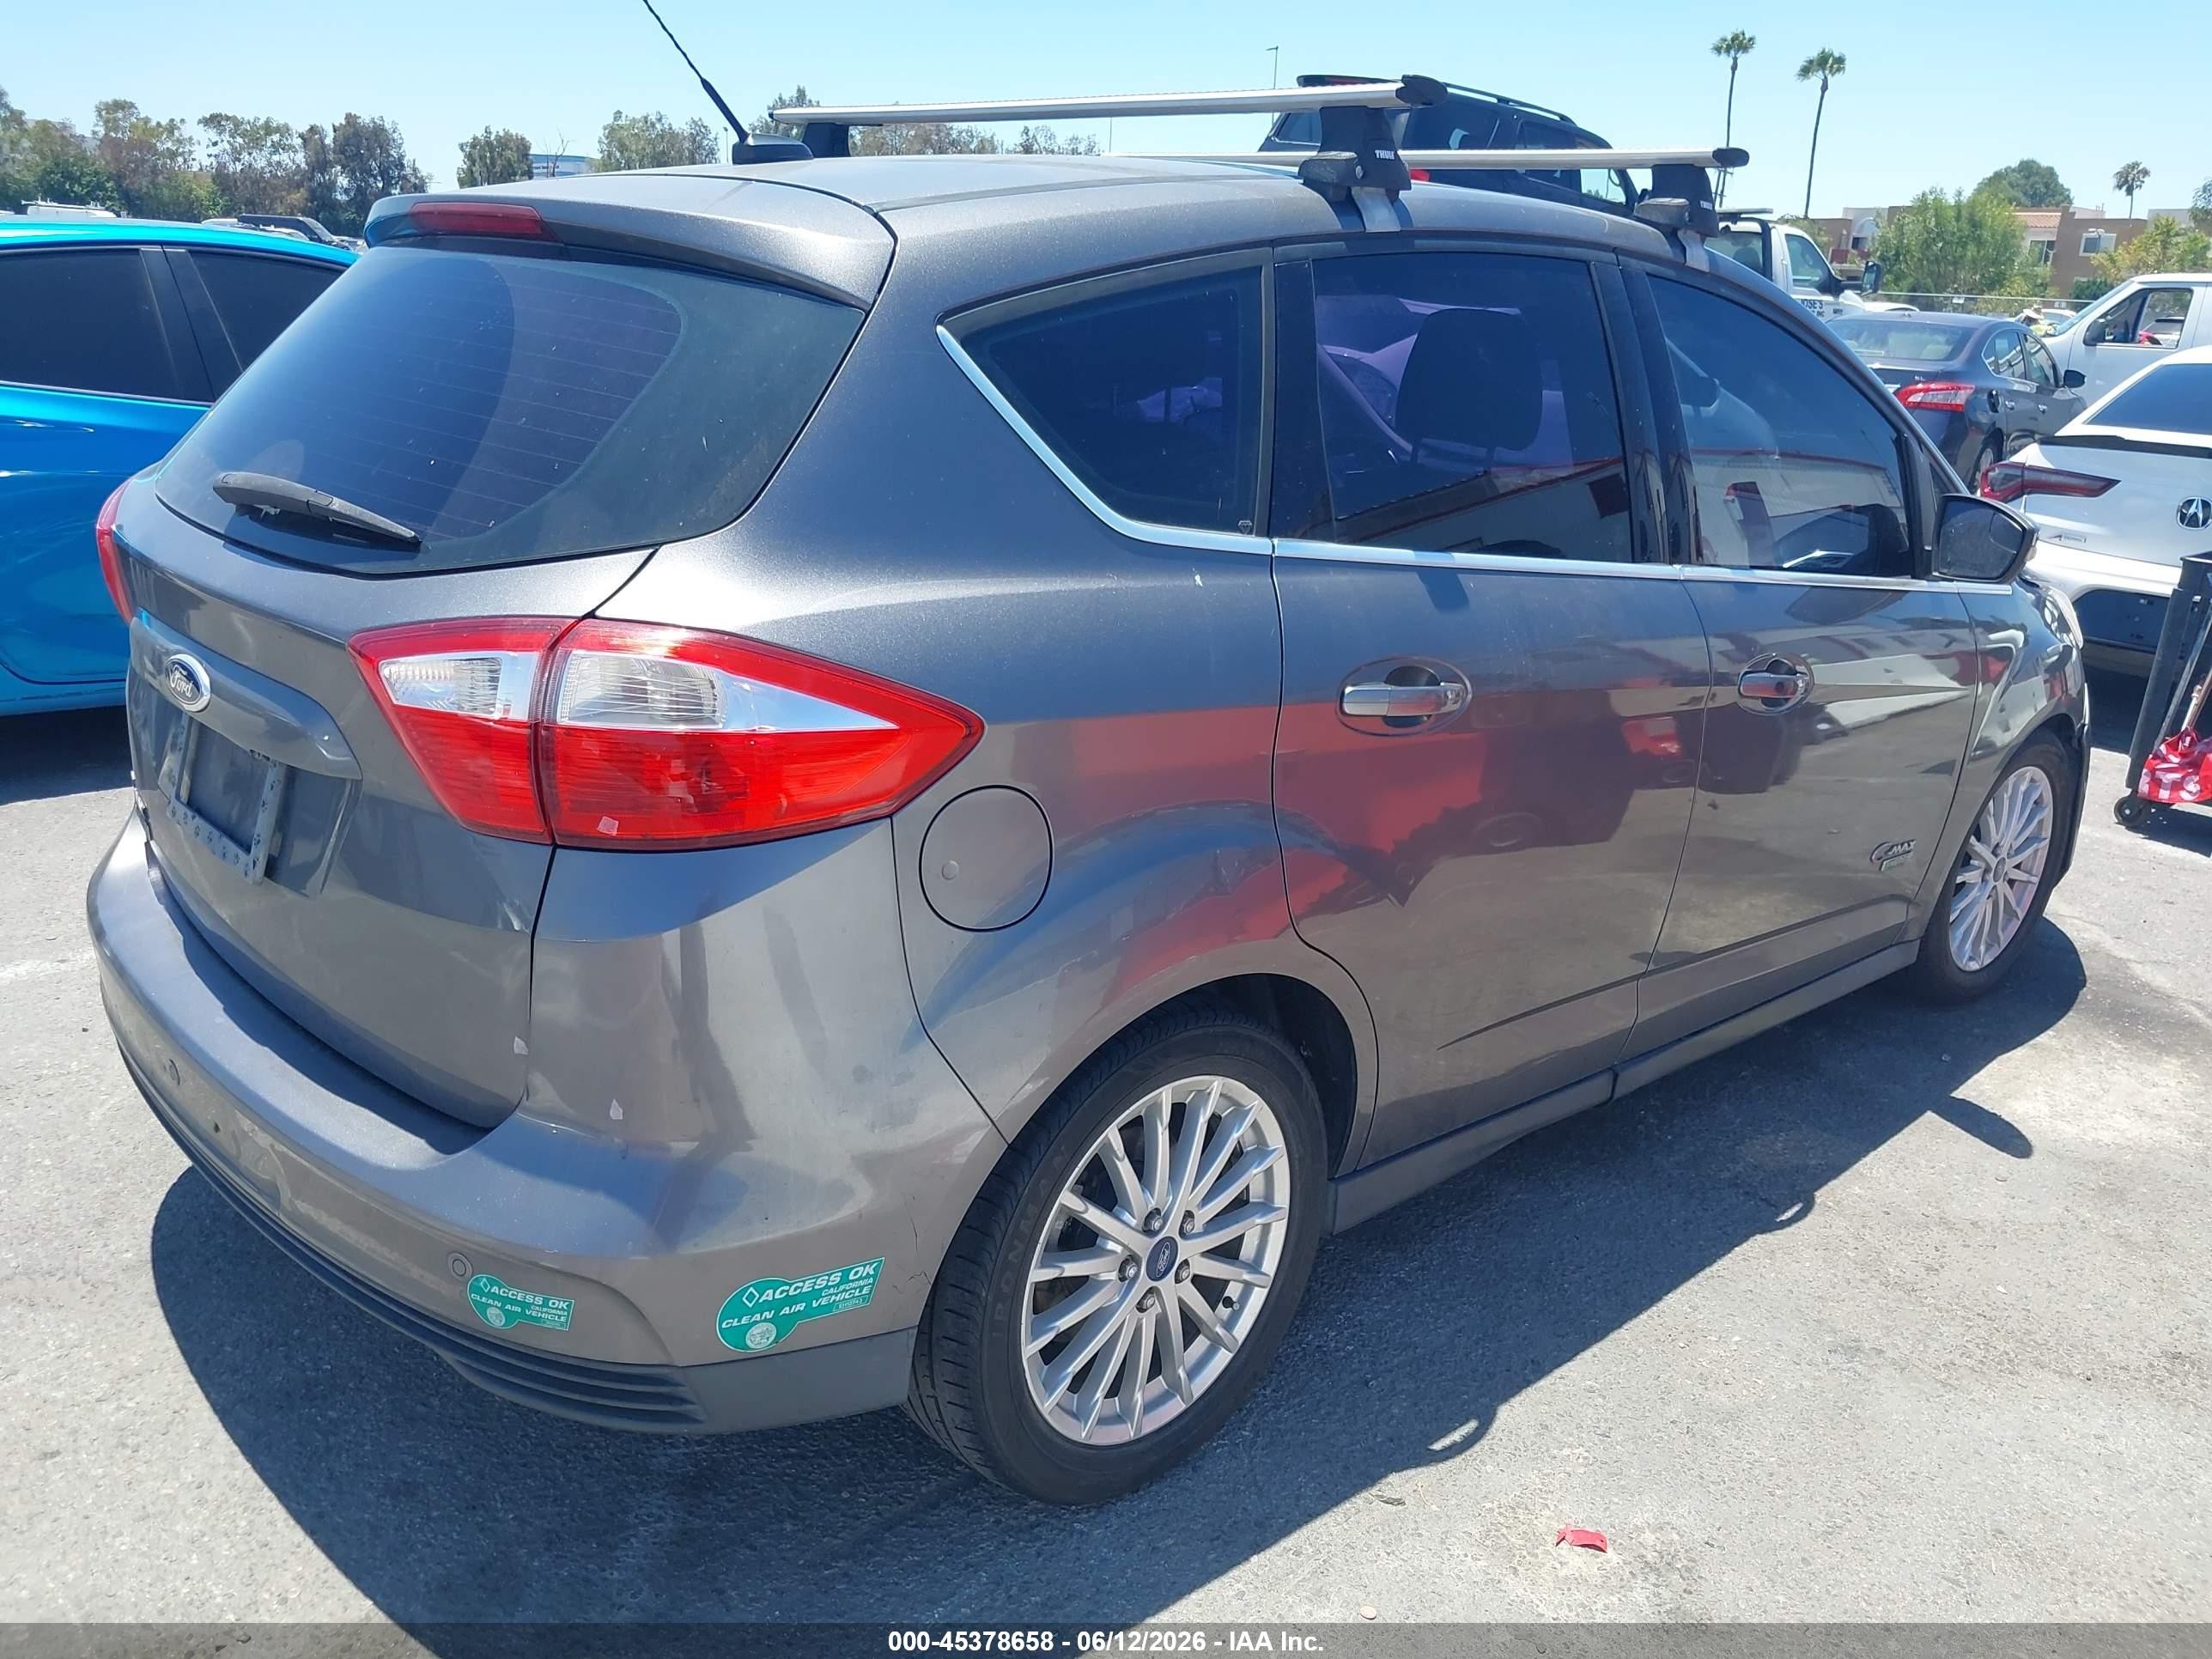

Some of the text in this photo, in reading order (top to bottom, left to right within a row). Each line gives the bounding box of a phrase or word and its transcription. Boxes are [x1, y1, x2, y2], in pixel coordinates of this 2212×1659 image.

[170, 664, 193, 698] Ford
[490, 1285, 570, 1310] ACCESS OK
[759, 1262, 880, 1304] ACCESS OK
[822, 1278, 873, 1297] CALIFORNIA
[471, 1293, 568, 1322] CLEAN AIR VEHICLE
[531, 1305, 568, 1316] CALIFORNIA
[721, 1309, 775, 1329] CLEAN
[779, 1302, 806, 1316] AIR
[811, 1285, 872, 1309] VEHICLE
